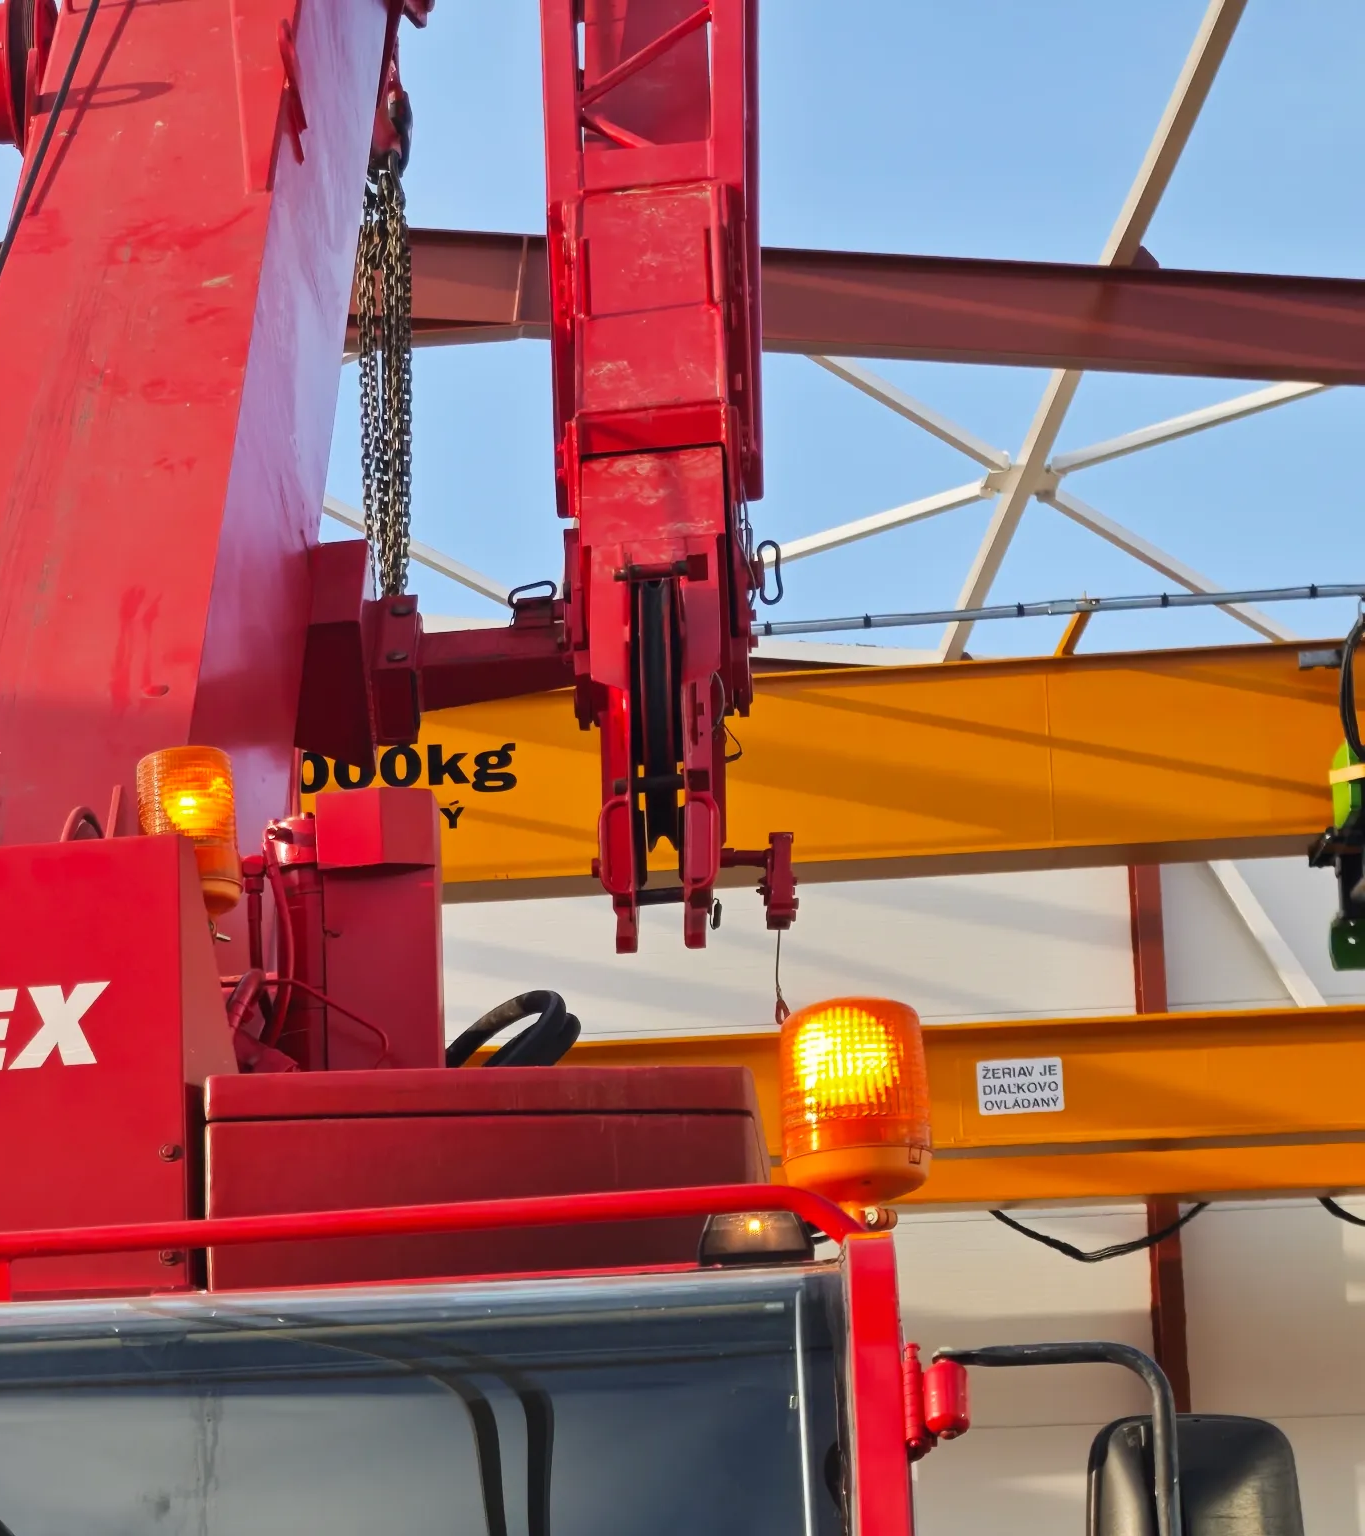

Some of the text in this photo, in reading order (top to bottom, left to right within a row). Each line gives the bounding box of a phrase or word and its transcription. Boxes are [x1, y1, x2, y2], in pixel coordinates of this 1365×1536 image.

[982, 1064, 1058, 1080] ŽERIAV JE
[984, 1094, 1059, 1111] OVLÁDANÝ
